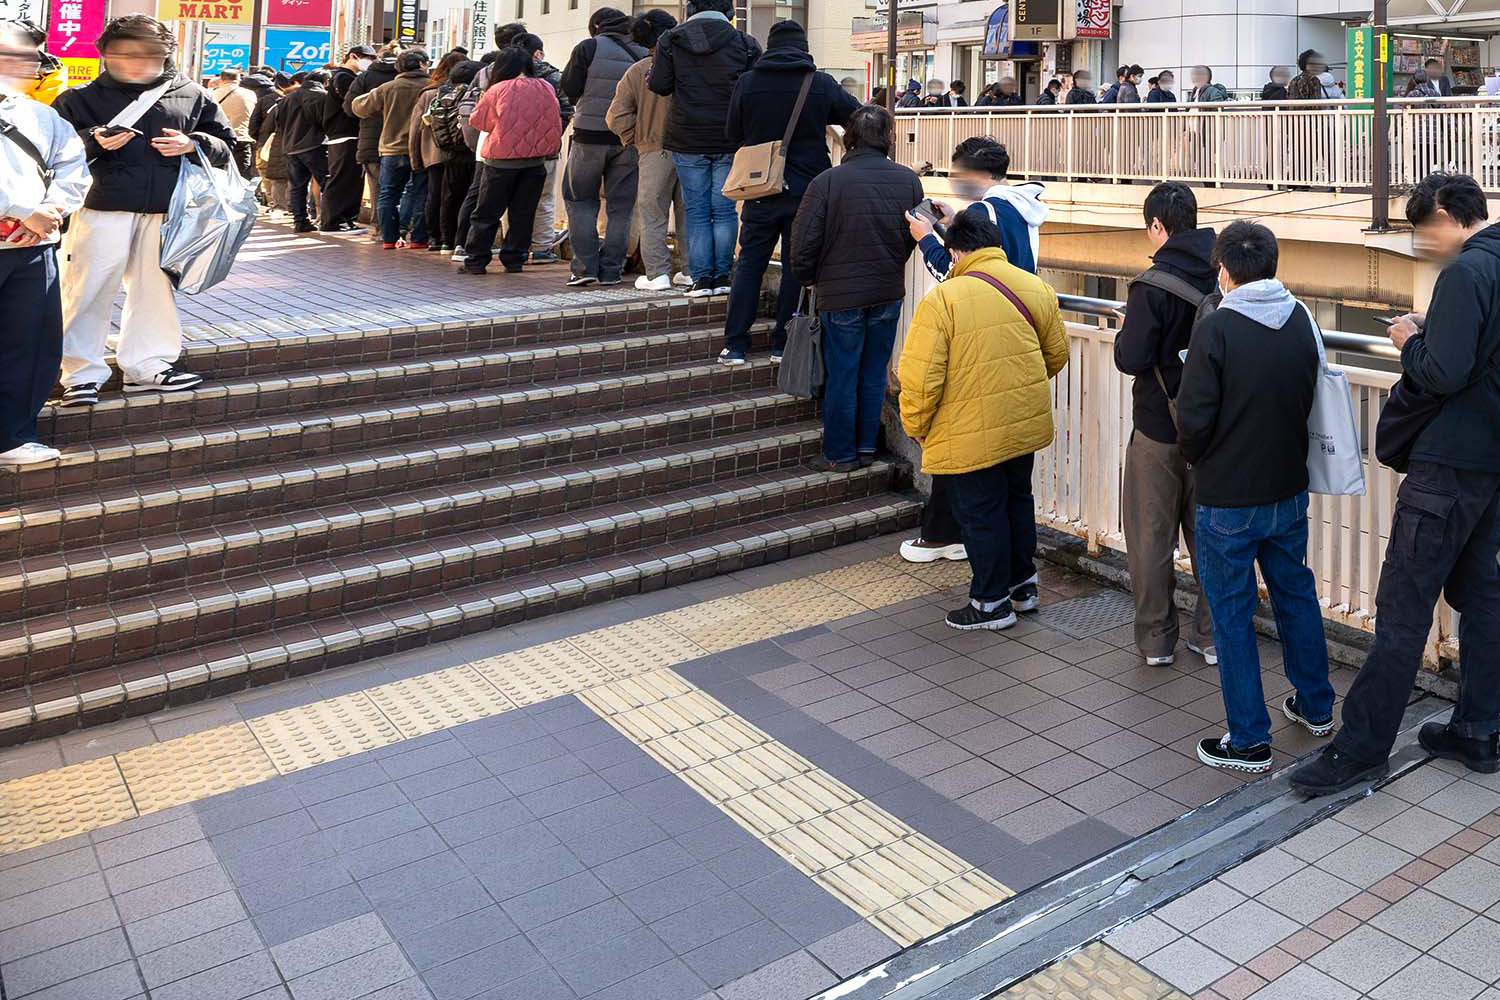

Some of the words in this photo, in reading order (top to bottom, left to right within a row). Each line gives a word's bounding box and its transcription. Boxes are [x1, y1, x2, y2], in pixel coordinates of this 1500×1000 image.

[178, 4, 243, 19] MART
[286, 42, 330, 59] Zof
[1354, 29, 1364, 99] 良文堂書店
